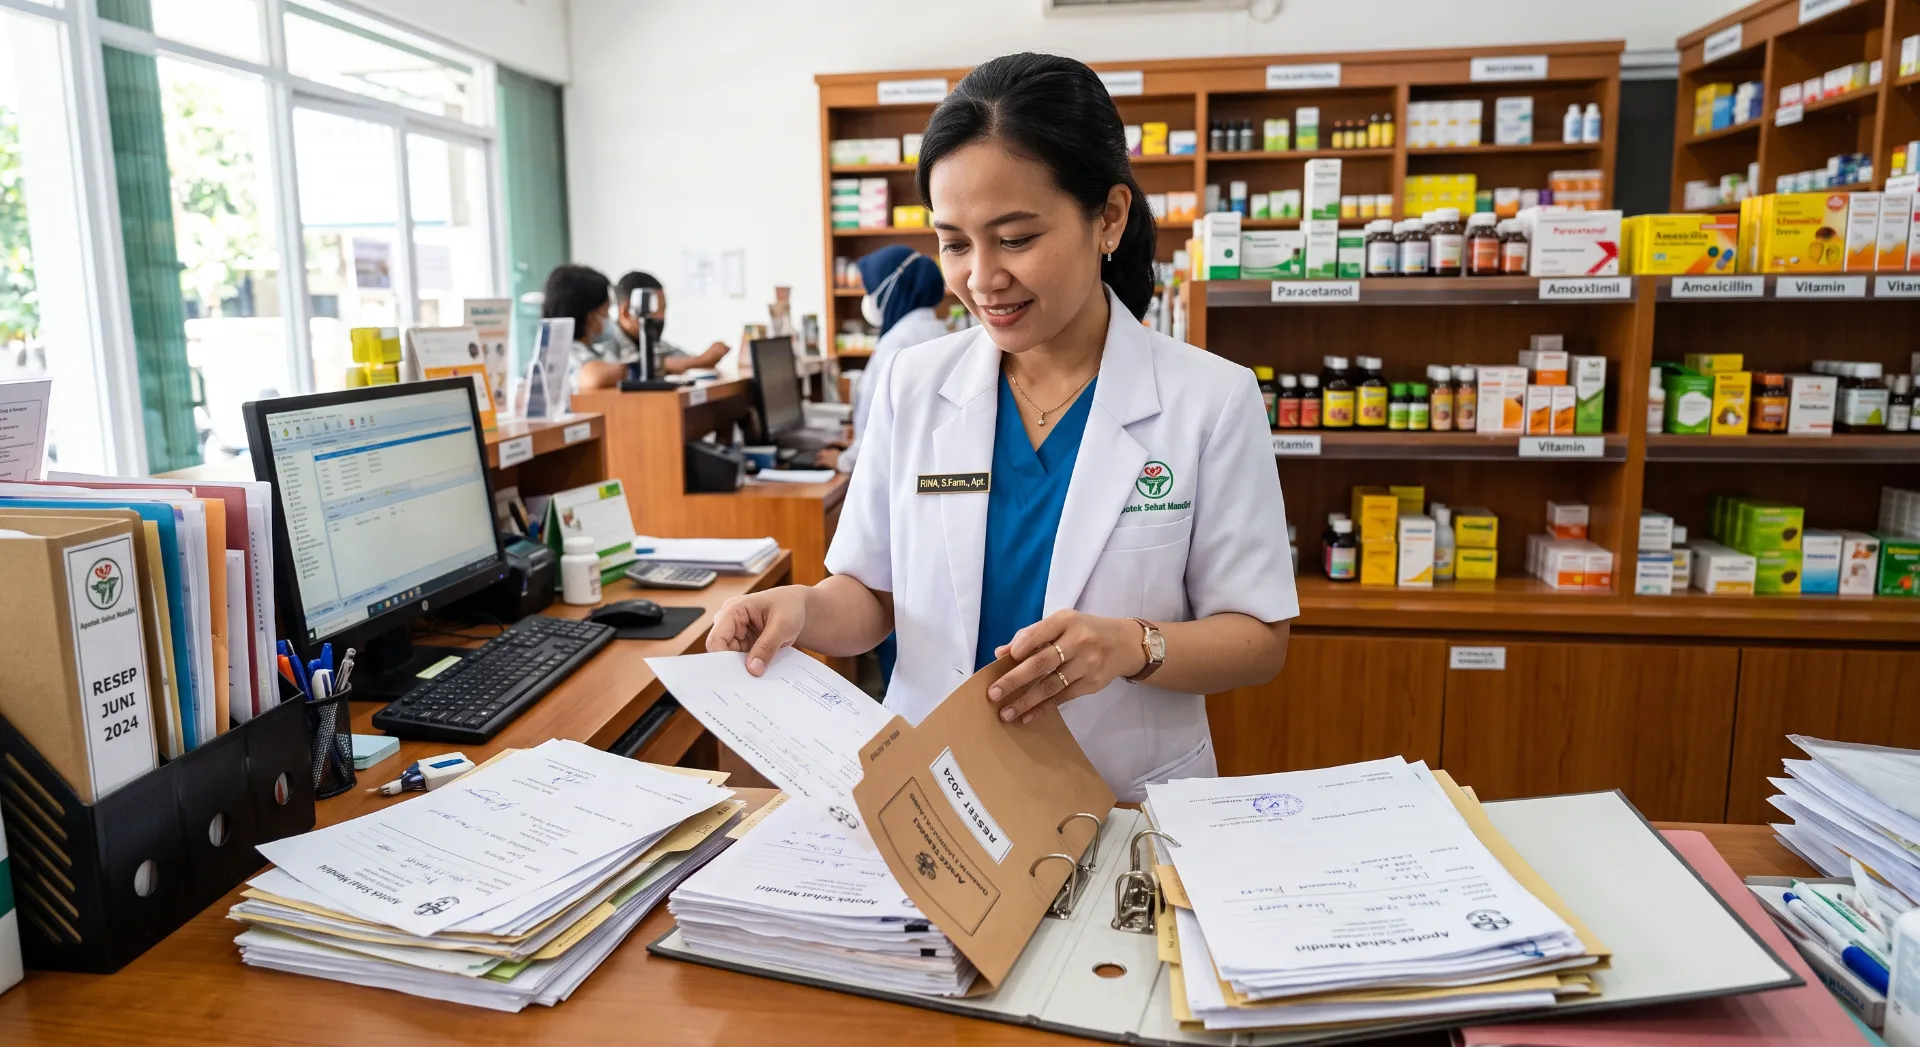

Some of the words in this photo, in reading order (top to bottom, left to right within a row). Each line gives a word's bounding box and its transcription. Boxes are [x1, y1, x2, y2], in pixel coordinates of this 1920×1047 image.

[1277, 286, 1353, 297] Paracetamol
[1681, 281, 1753, 293] Amoxicillin
[1795, 281, 1846, 293] Vitamin
[1538, 440, 1586, 453] Vitamin
[920, 478, 940, 489] RINA,
[970, 477, 986, 488] Apt.
[1120, 503, 1143, 515] potek
[1144, 502, 1167, 512] Sehat
[92, 667, 138, 697] RESEP
[101, 691, 137, 719] JUNI
[104, 714, 139, 742] 2024
[943, 767, 964, 799] 2024
[754, 884, 800, 897] Mandiri
[801, 892, 834, 902] Sehat
[837, 896, 879, 905] Apotek
[1354, 938, 1396, 948] Sehat
[1400, 931, 1450, 944] Apotek
[1294, 941, 1351, 954] Mandiri
